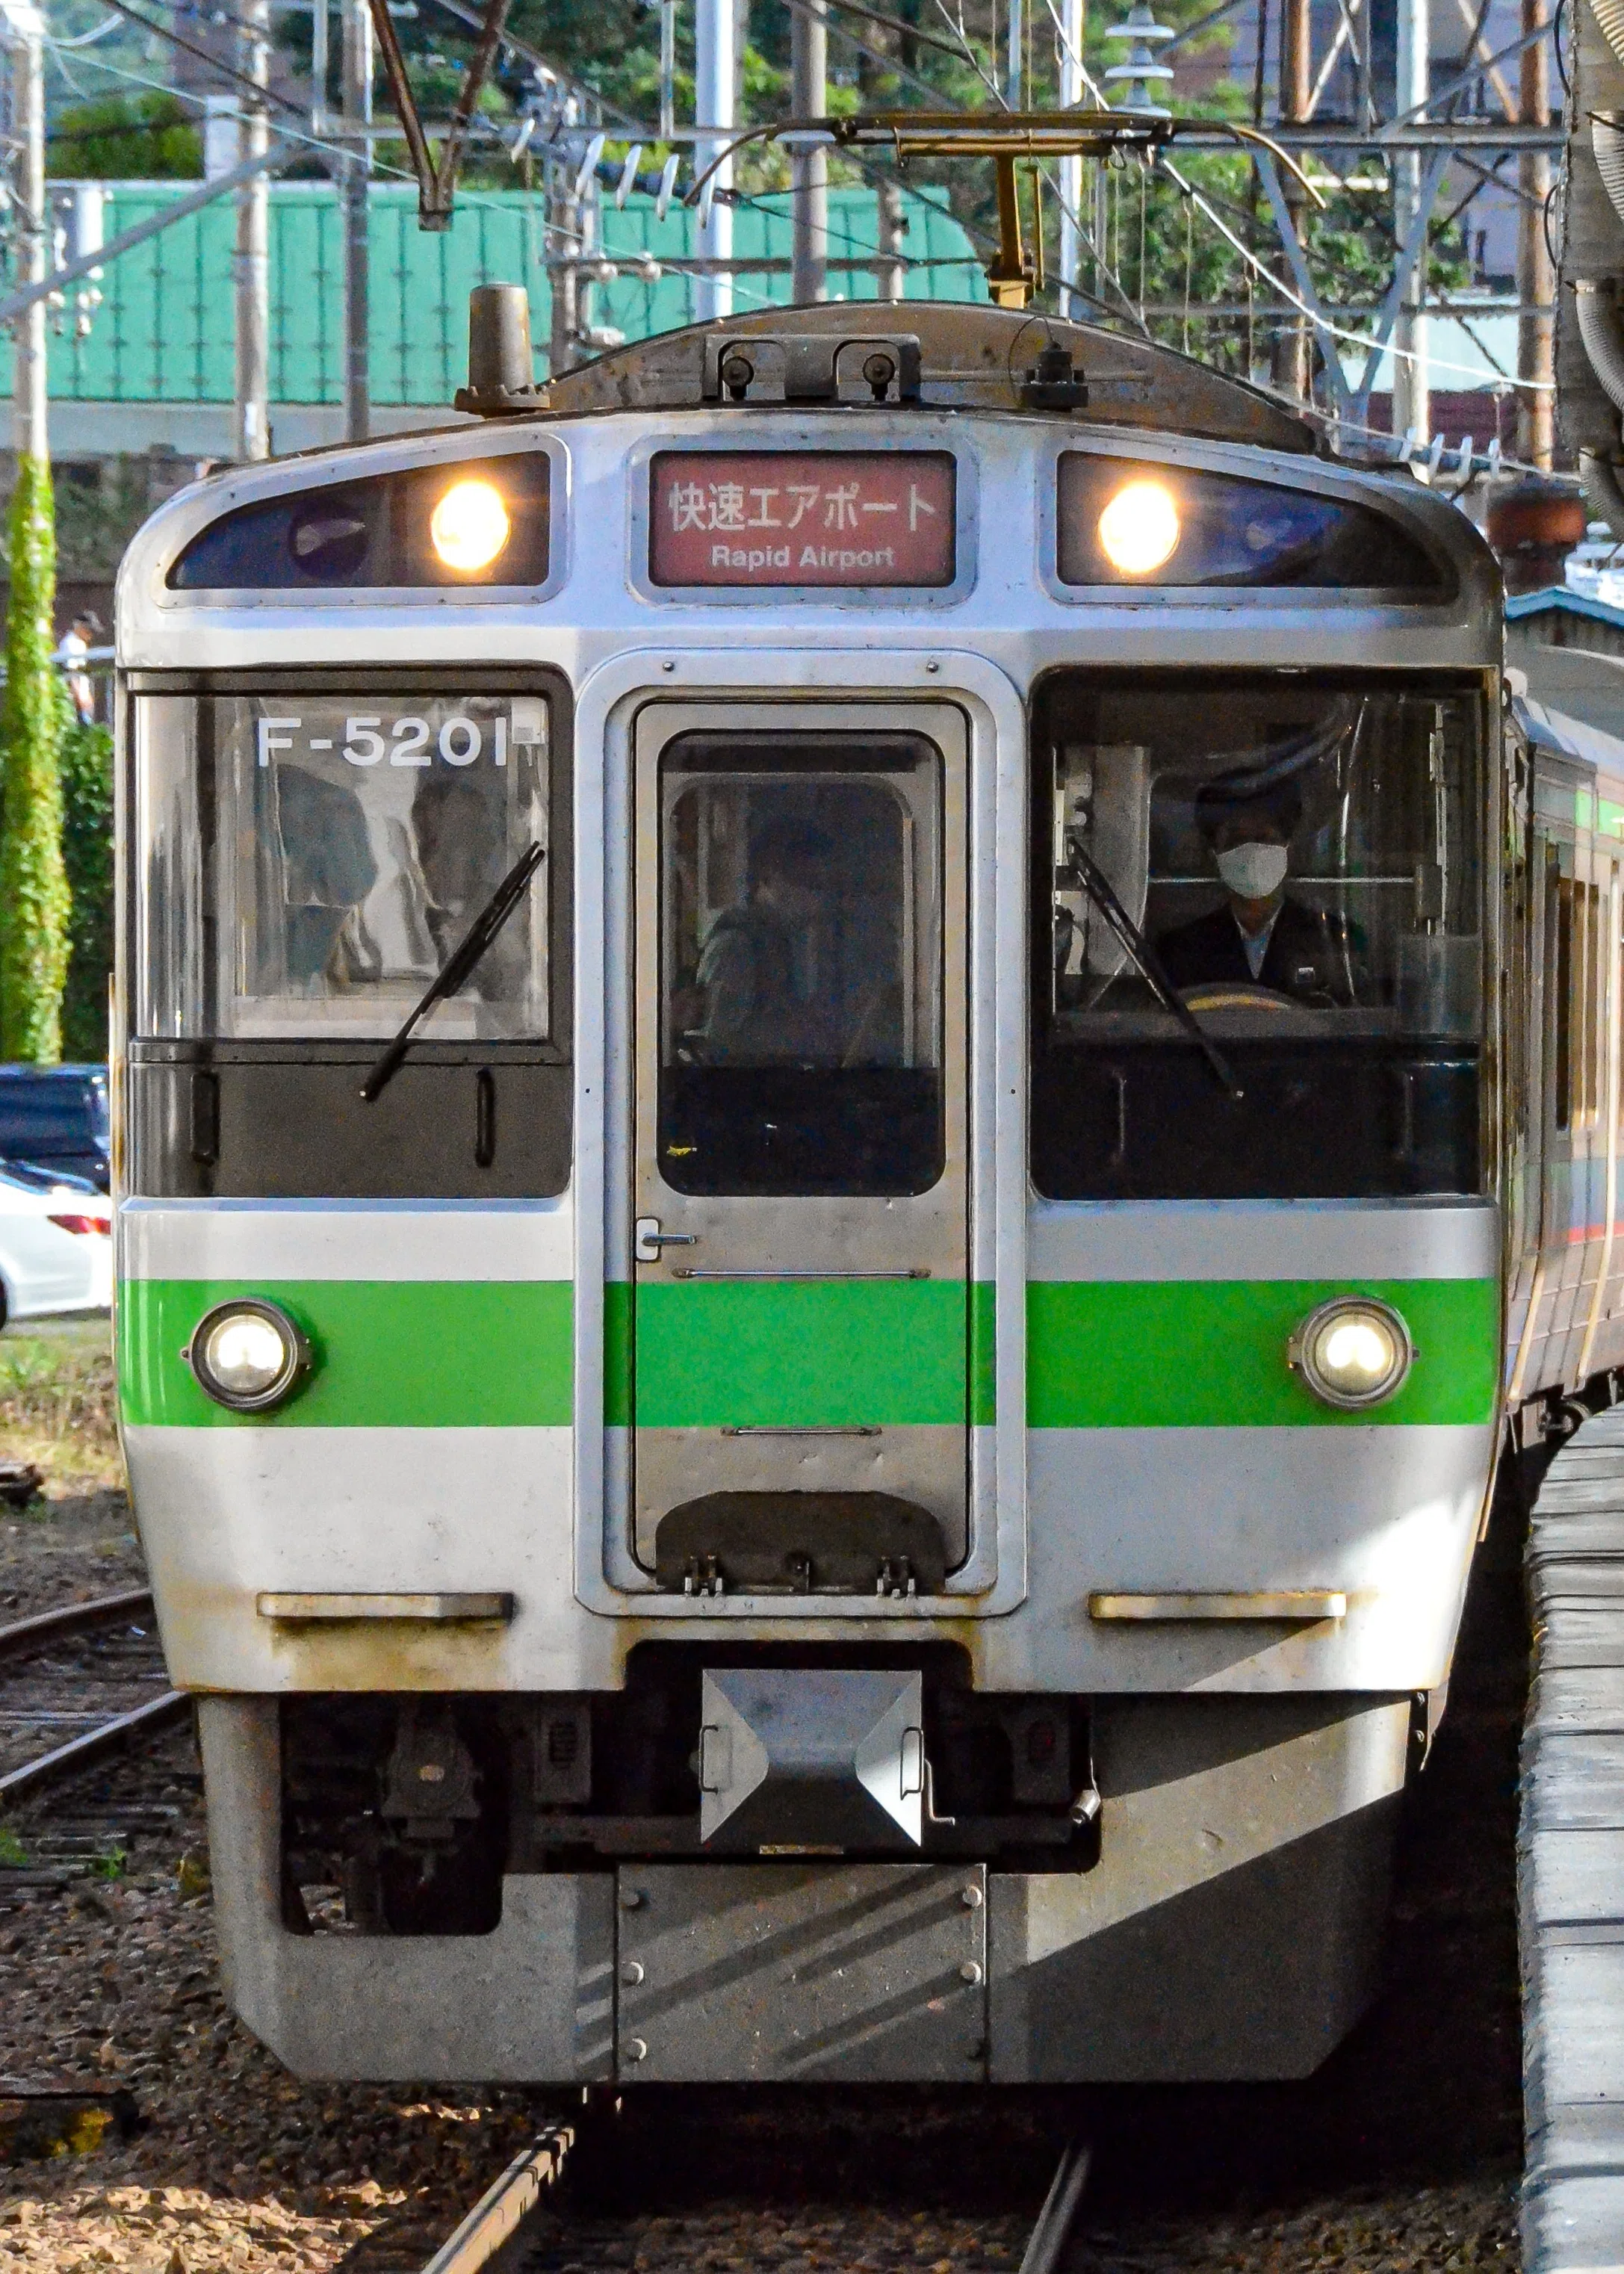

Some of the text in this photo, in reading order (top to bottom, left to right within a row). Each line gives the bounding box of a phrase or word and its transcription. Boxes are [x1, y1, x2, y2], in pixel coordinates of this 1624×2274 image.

[669, 482, 935, 531] 快速エアポート
[711, 546, 896, 572] Rapid Airport
[258, 717, 506, 766] F-5201
